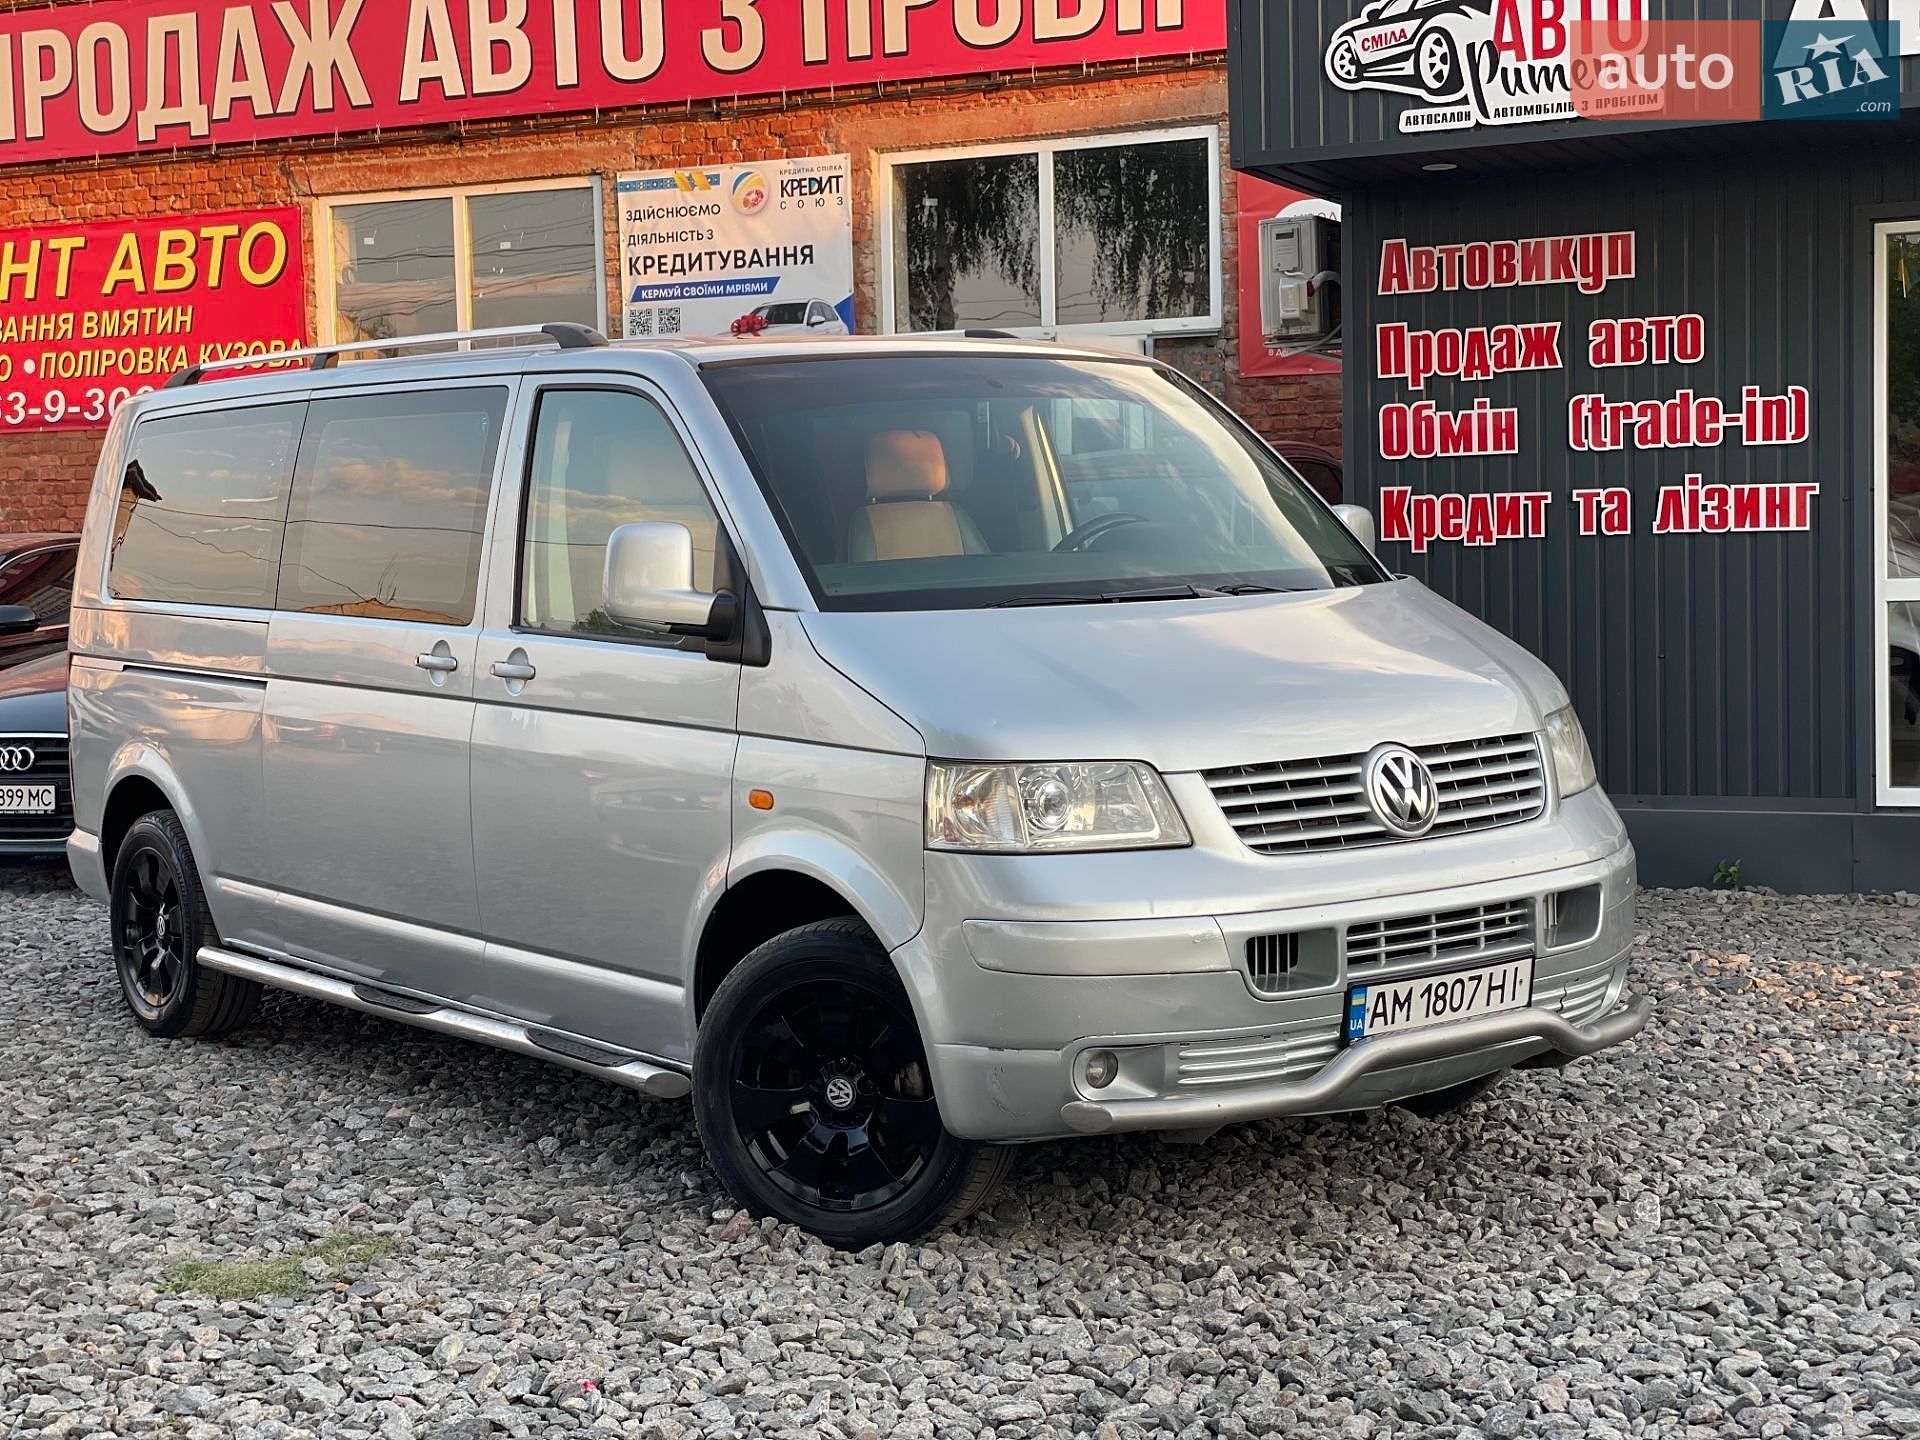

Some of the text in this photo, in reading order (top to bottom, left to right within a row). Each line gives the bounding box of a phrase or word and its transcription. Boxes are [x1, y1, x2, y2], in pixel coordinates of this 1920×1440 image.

[1361, 27, 1408, 52] СМІЛА
[1404, 111, 1472, 127] АВТОСАЛОН
[1493, 102, 1575, 119] АВТОМОБІЛІВ
[1596, 94, 1658, 110] ПРОБІГОМ
[626, 204, 721, 222] ЗДІЙСНЮЄМО
[628, 230, 704, 247] ДІЯЛЬНІСТЬ
[102, 221, 288, 297] АВТО
[628, 244, 815, 276] КРЕДИТУВАННЯ
[1378, 231, 1635, 295] Автовикуп
[641, 282, 768, 299] КЕРМУЙ СВОЇМИ МРІЯМИ
[82, 304, 194, 339] ВМЯТИН
[40, 345, 189, 379] ПОЛІРОВКА
[1376, 314, 1704, 390] Продаж авто
[1379, 385, 1809, 459] Обмін (trade-in)
[1380, 474, 1820, 553] Кредит та лізинг
[28, 789, 52, 807] MC
[1368, 966, 1519, 1029] AM 1807 HI
[1350, 1018, 1364, 1030] UA
